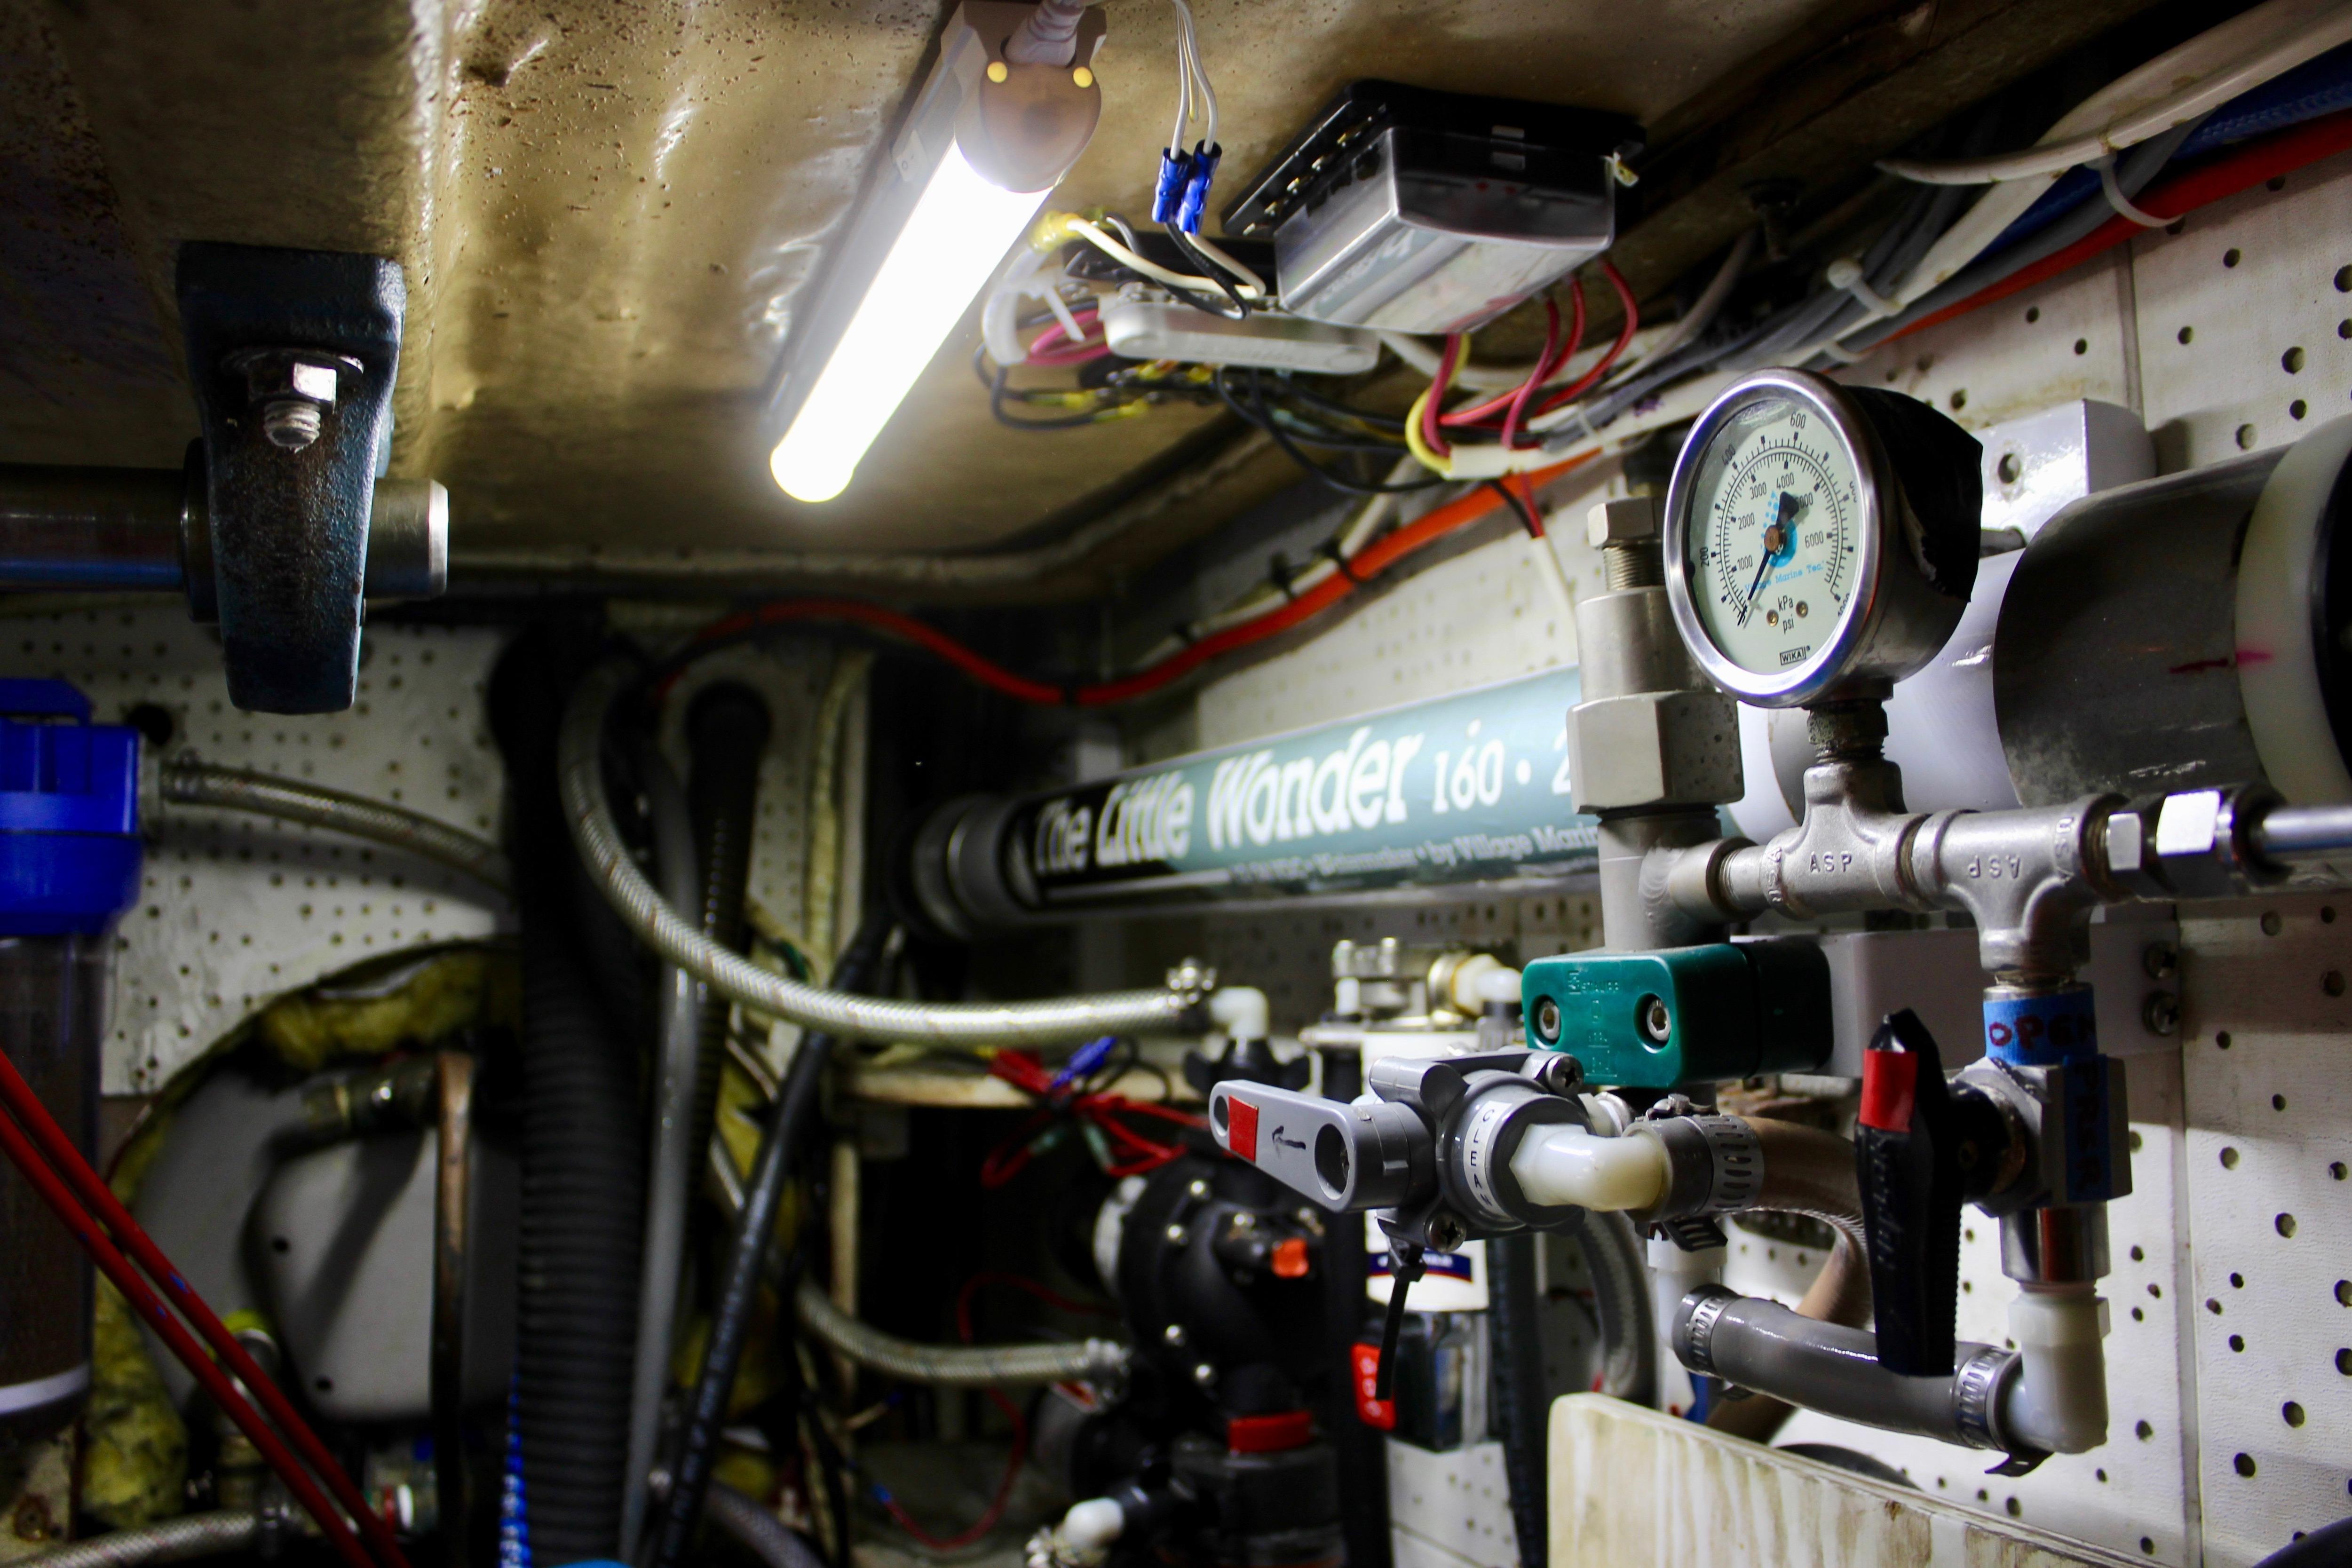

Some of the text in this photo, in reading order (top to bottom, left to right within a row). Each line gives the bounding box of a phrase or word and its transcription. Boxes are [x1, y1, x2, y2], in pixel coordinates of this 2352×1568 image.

[1790, 412, 1806, 428] 600
[1722, 444, 1735, 466] 400
[1777, 472, 1794, 490] 4000
[1750, 482, 1766, 500] 3000
[1796, 492, 1813, 509] 000
[1738, 513, 1755, 530] 2000
[1805, 531, 1824, 548] 6000
[1700, 546, 1710, 568] 200
[1737, 555, 1753, 570] 1000
[1775, 570, 1803, 584] Marine
[1778, 595, 1794, 612] kPa
[1783, 614, 1794, 634] psi
[1781, 649, 1803, 663] WIKA
[1036, 797, 1092, 874] The
[1096, 769, 1195, 866] Little
[1207, 726, 1425, 851] Wonder
[1433, 739, 1505, 814] 160
[1426, 840, 1457, 867] by
[1453, 833, 1533, 861] Village
[1810, 851, 1852, 872] ASP
[1968, 854, 2021, 879] ASP
[1471, 1109, 1495, 1206] CLEAN
